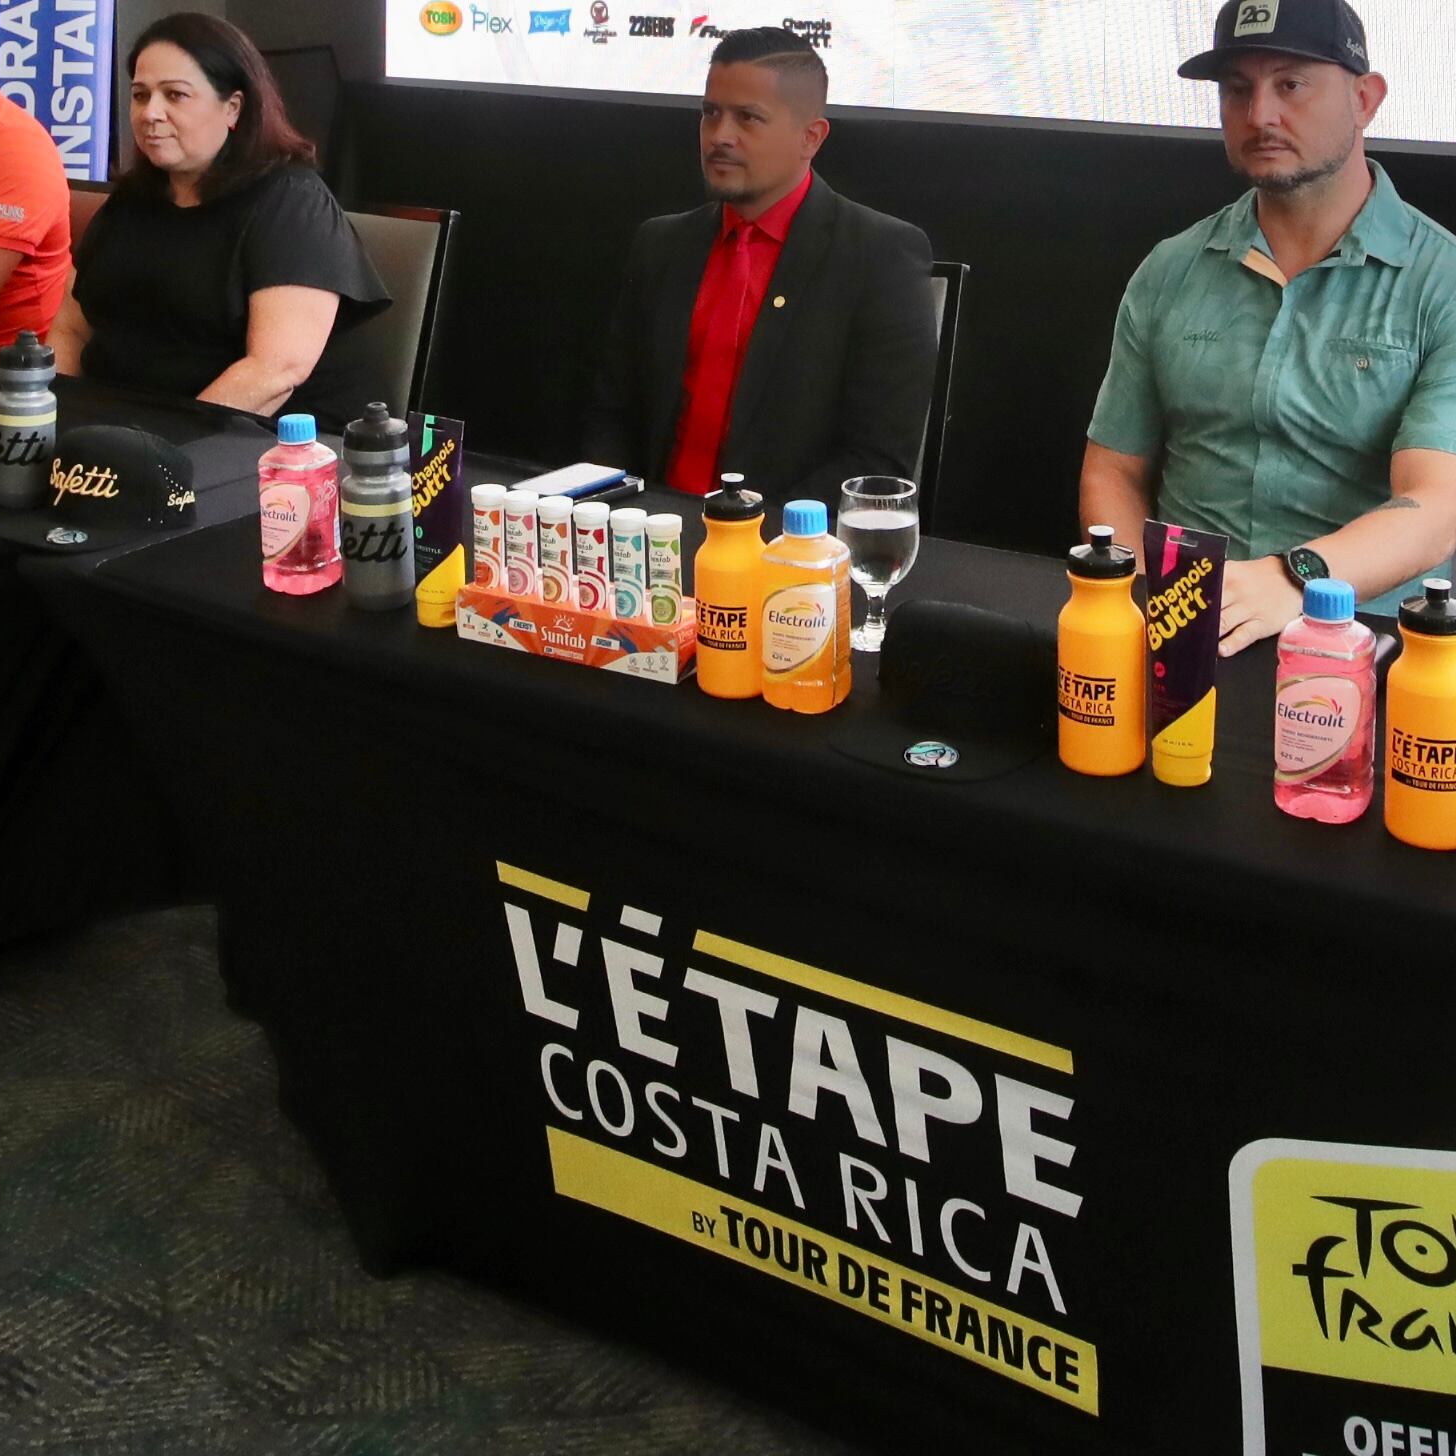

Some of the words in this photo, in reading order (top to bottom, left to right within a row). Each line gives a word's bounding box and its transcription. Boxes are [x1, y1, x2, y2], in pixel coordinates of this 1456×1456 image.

[426, 10, 456, 24] TOSH
[629, 15, 675, 38] 226ERS
[50, 458, 119, 506] Safetti
[769, 610, 827, 629] Electrolit
[541, 626, 587, 649] Suntab
[720, 629, 745, 640] RICA
[1085, 701, 1113, 715] RICA
[1277, 702, 1346, 729] Electrolit
[1392, 754, 1426, 778] COSTA
[504, 901, 1084, 1219] L'ÉTAPE
[541, 1042, 806, 1211] COSTA
[839, 1152, 1067, 1316] RICA
[691, 1208, 718, 1238] BY
[719, 1205, 828, 1287] TOUR
[838, 1252, 891, 1313] DE
[900, 1279, 1080, 1395] FRANCE
